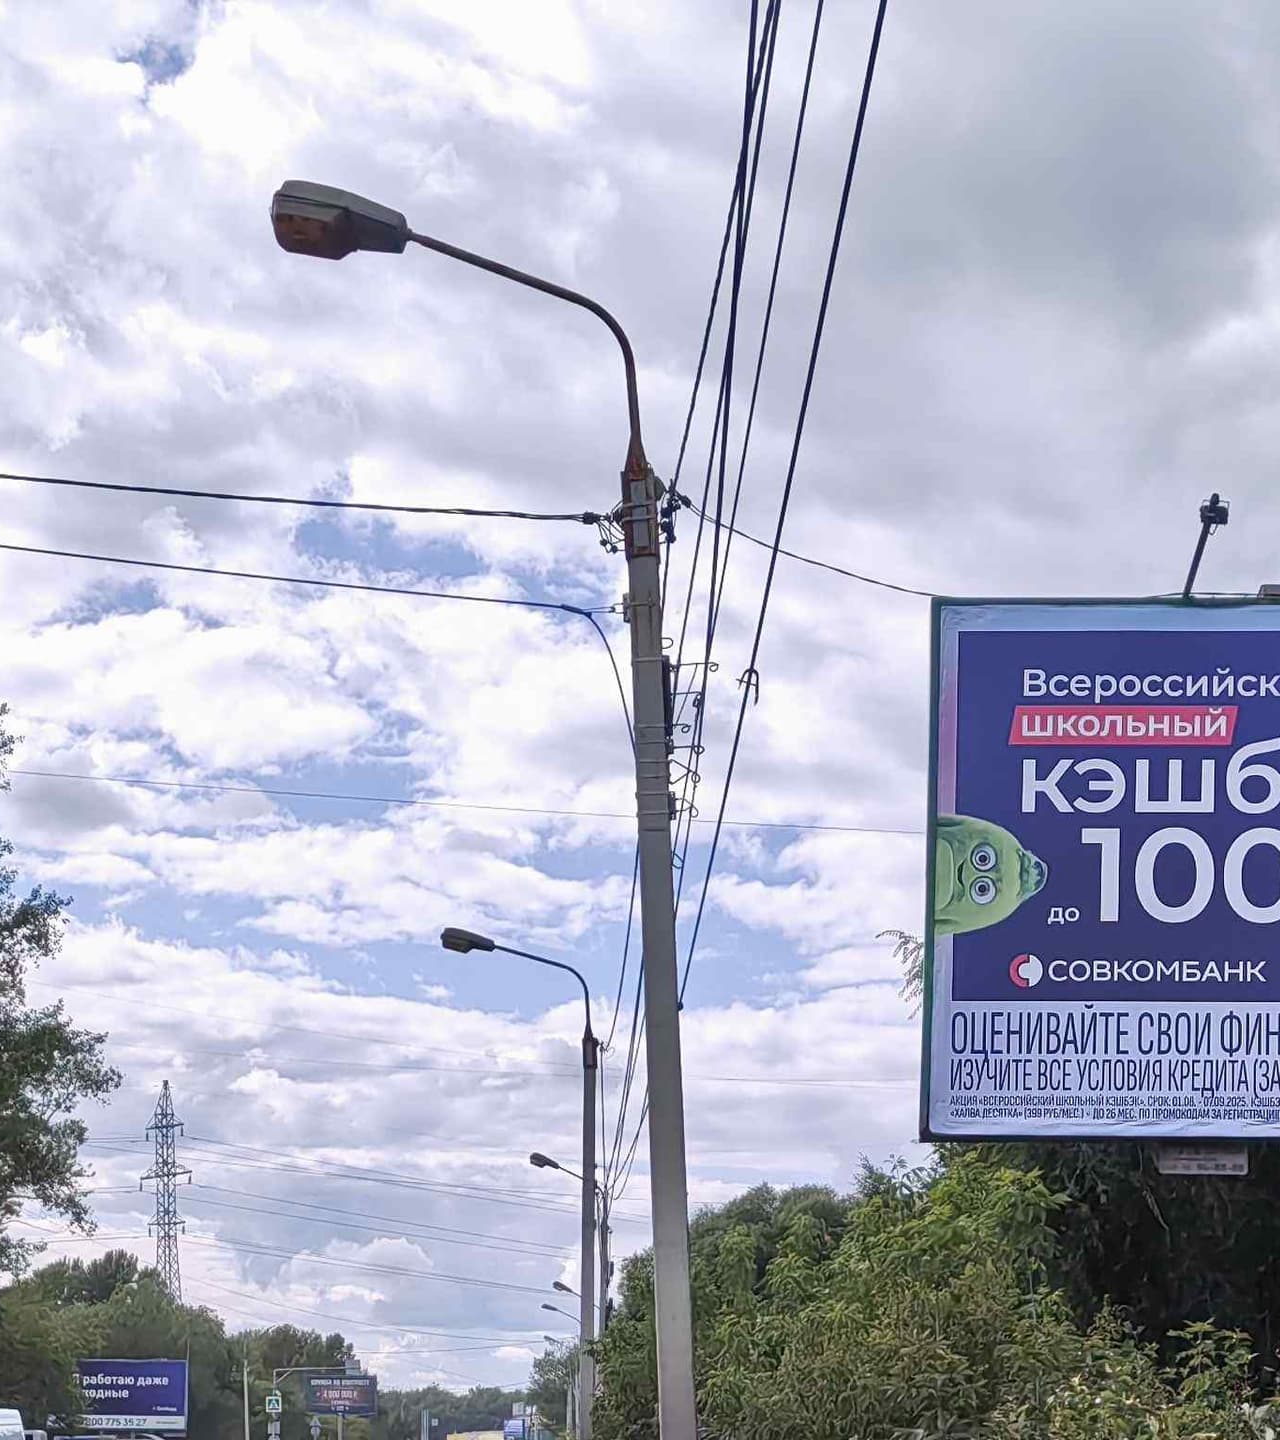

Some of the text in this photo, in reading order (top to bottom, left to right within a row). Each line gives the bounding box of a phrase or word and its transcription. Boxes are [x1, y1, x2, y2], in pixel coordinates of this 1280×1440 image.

[1047, 905, 1080, 925] до
[1048, 960, 1267, 983] СОВКОМБАНК
[950, 1003, 1130, 1062] ОЦЕНИВАЙТЕ
[1138, 1011, 1212, 1056] СВОИ
[950, 1058, 1033, 1091] ИЗУЧИТЕ
[1038, 1058, 1072, 1091] ВСЕ
[1077, 1058, 1162, 1091] УСЛОВИЯ
[1169, 1059, 1249, 1097] КРЕДИТА
[82, 1373, 135, 1387] работаю
[136, 1376, 169, 1387] даже
